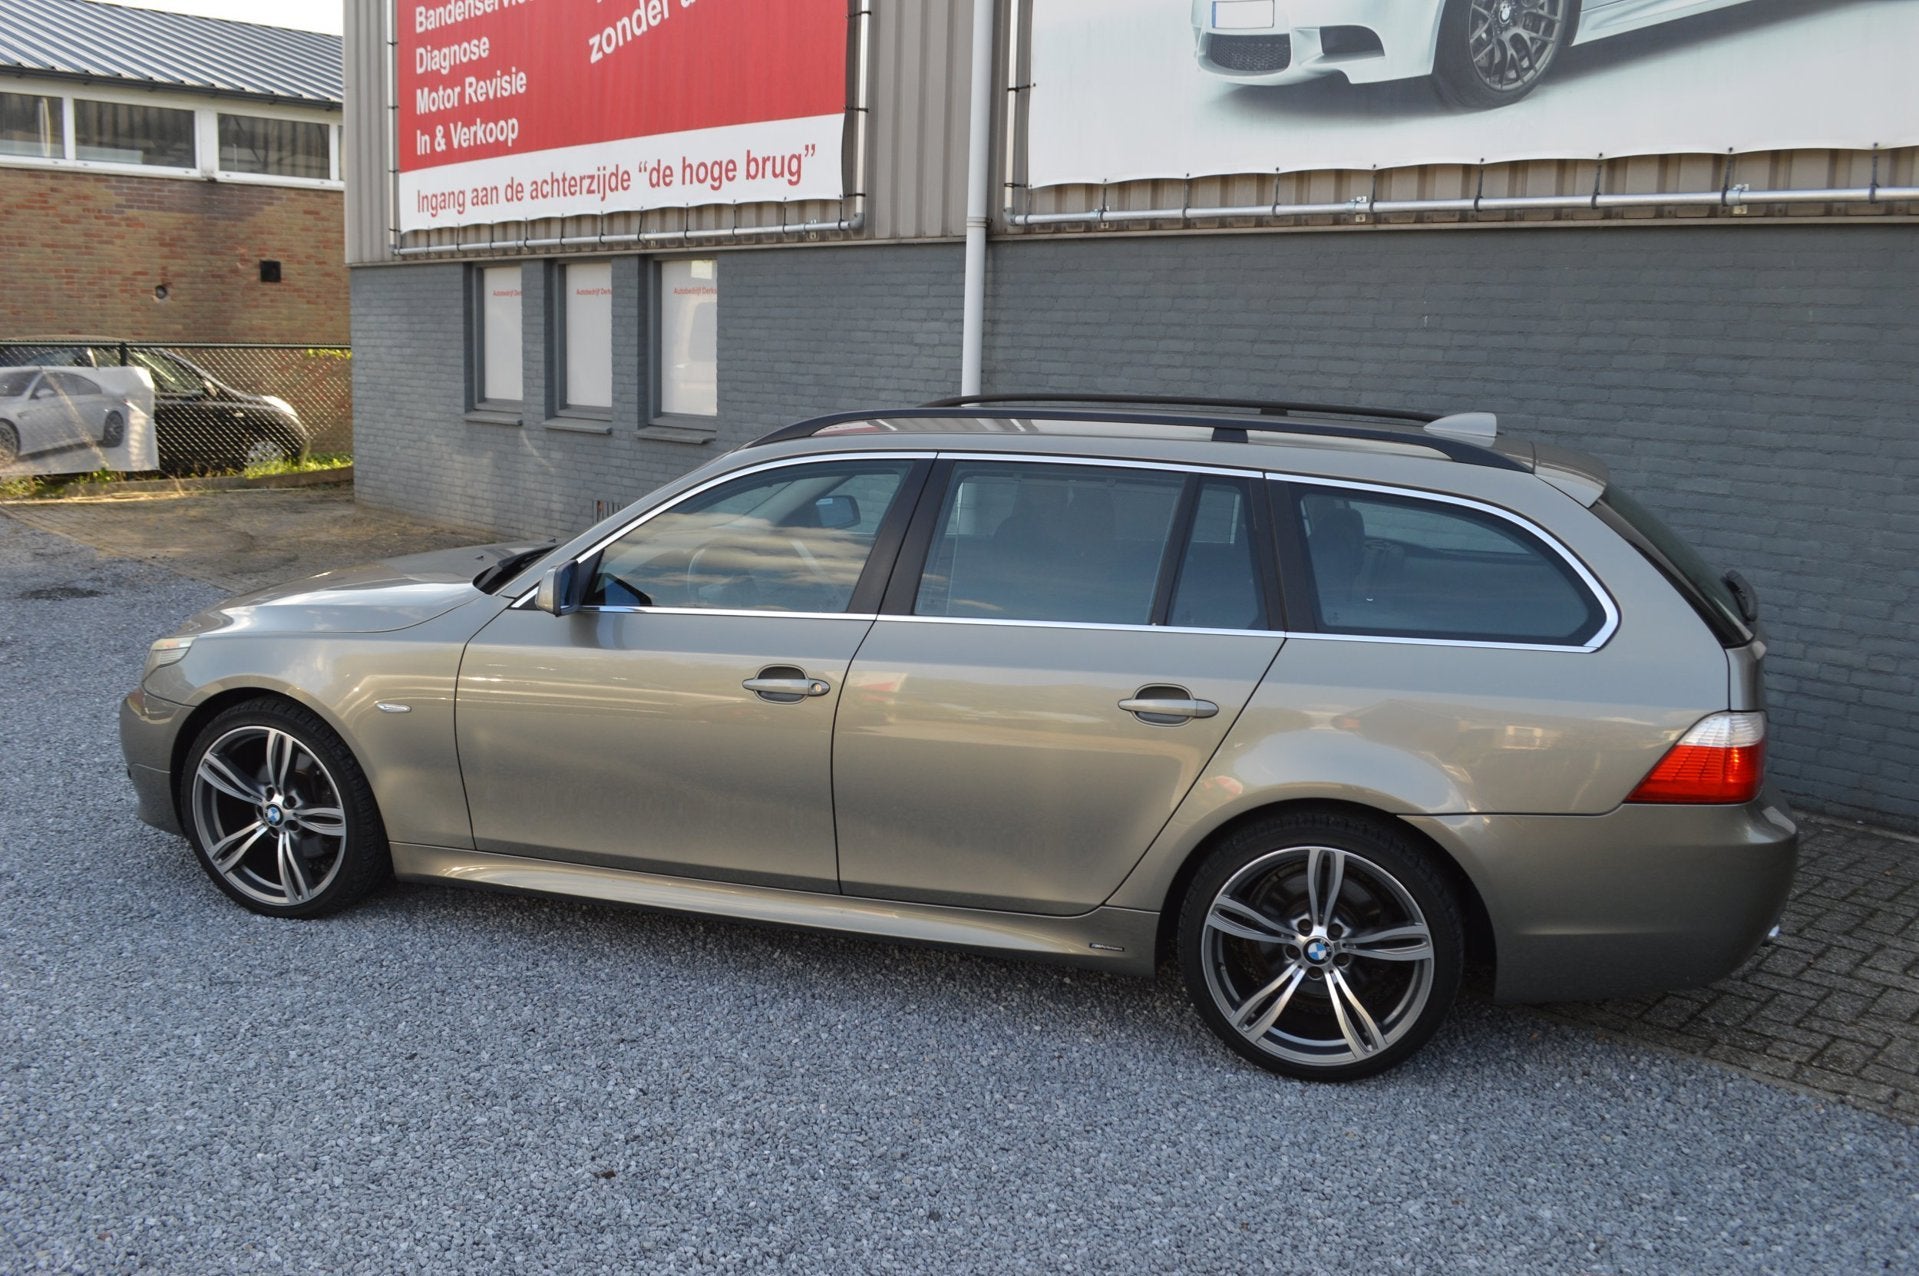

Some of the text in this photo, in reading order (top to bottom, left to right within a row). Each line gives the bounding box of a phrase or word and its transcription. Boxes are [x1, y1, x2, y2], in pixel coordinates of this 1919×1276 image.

[416, 0, 534, 33] Bandenser
[416, 36, 490, 75] Diagnose
[416, 66, 527, 115] Motor Revisie
[416, 117, 519, 156] In & Verkoop
[416, 189, 466, 218] Ingang
[471, 185, 500, 207] aan
[504, 177, 525, 203] de
[529, 164, 632, 202] achterzijde
[681, 156, 738, 191] hoge
